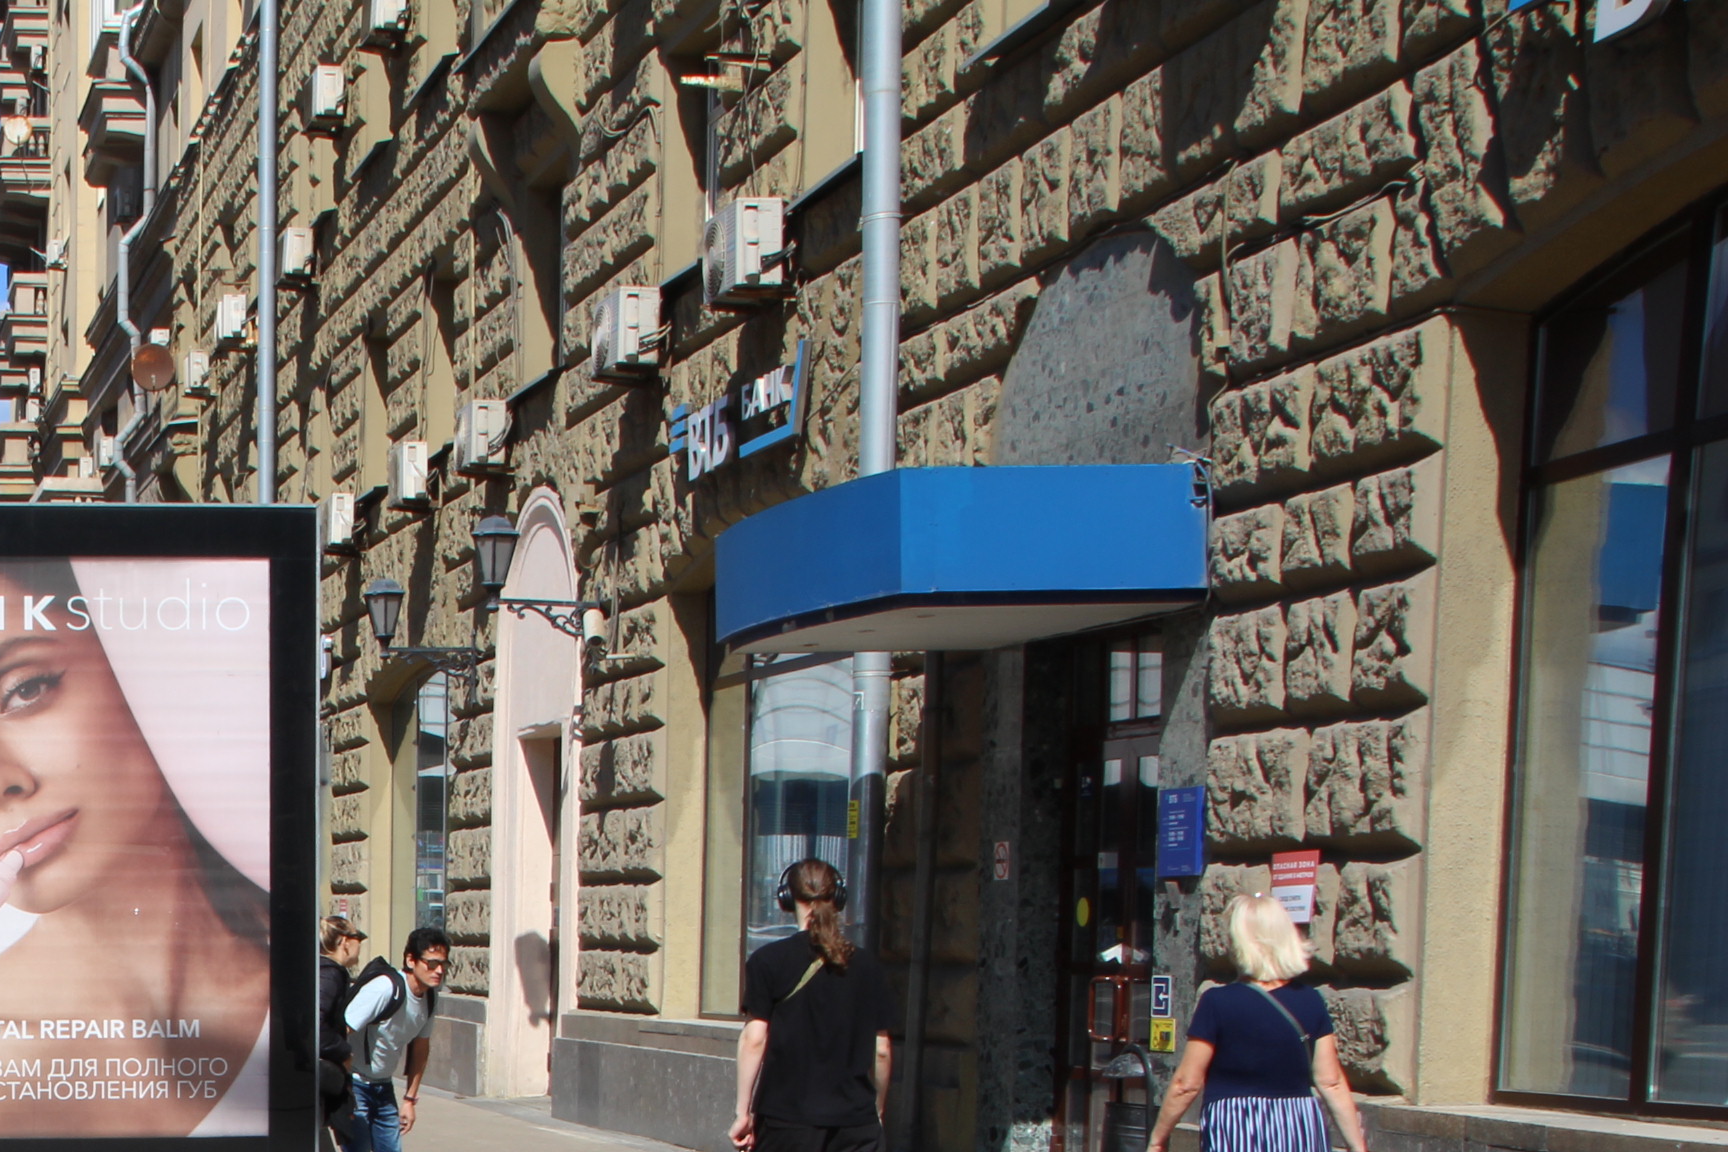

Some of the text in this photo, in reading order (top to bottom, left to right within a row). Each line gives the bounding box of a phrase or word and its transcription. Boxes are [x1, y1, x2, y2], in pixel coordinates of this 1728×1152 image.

[687, 364, 794, 482] ВТБ БАНК
[40, 1019, 125, 1040] REPAIR
[132, 1018, 201, 1040] BALM
[47, 1058, 98, 1082] ДЛЯ
[105, 1056, 229, 1078] ПОЛНОГО
[176, 1079, 218, 1100] ГУБ
